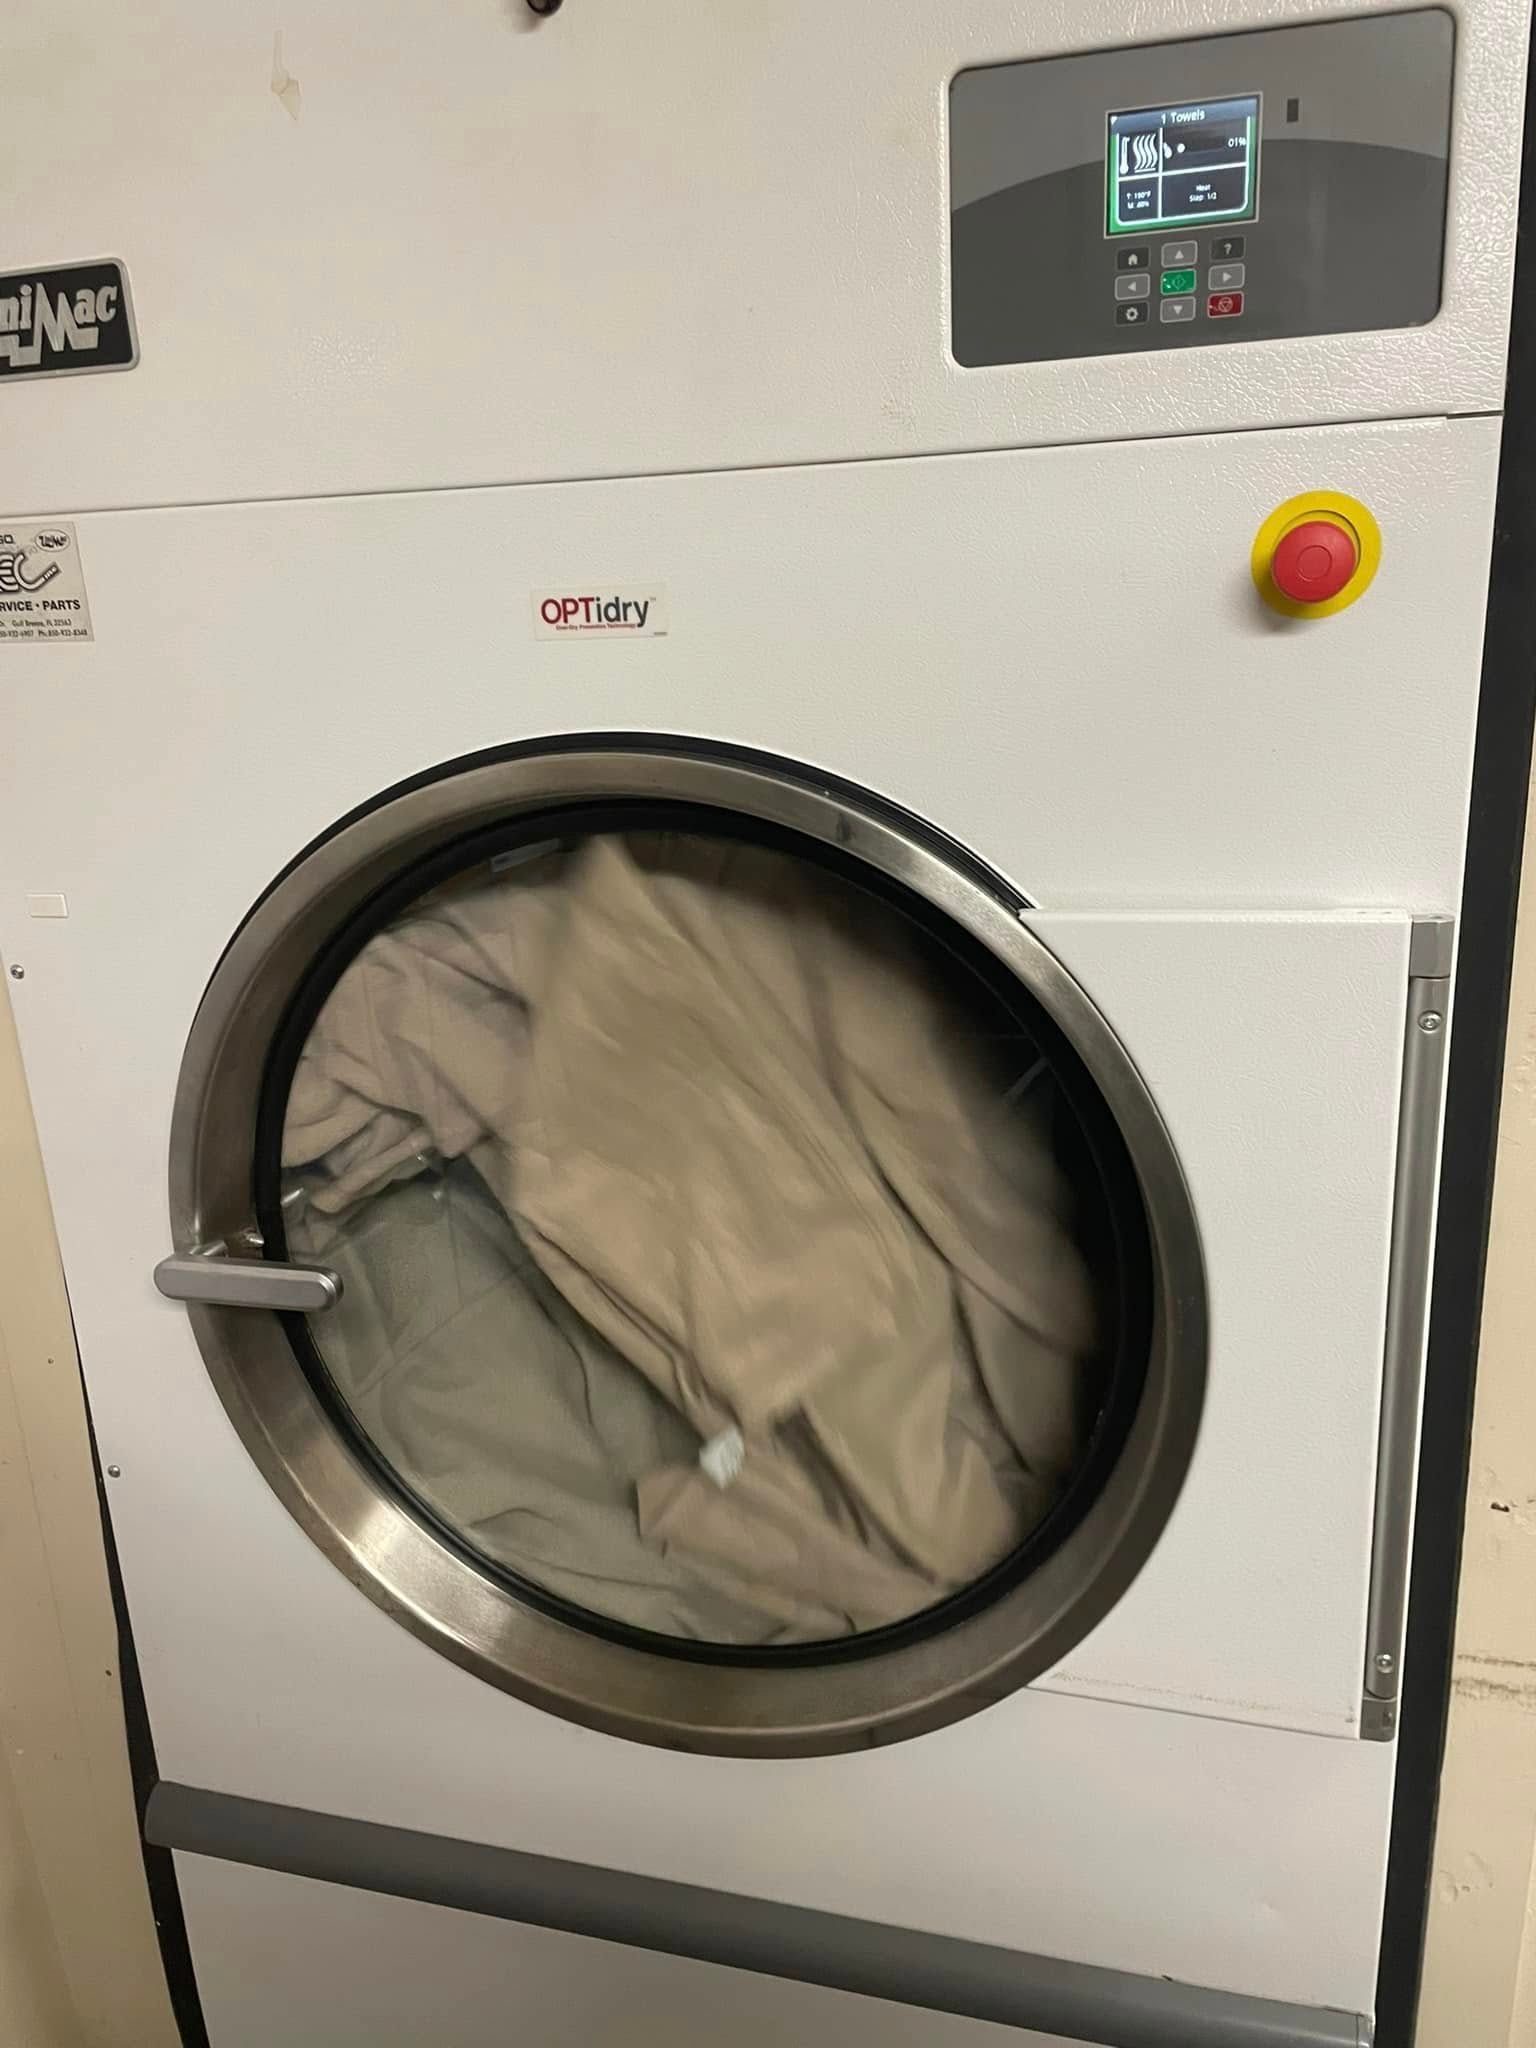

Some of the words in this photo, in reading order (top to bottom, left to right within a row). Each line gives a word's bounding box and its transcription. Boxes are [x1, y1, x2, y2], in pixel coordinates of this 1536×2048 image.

[1161, 113, 1167, 125] 1
[1171, 109, 1206, 124] Towels
[42, 599, 81, 611] PARTS
[540, 596, 649, 628] OPTidry
